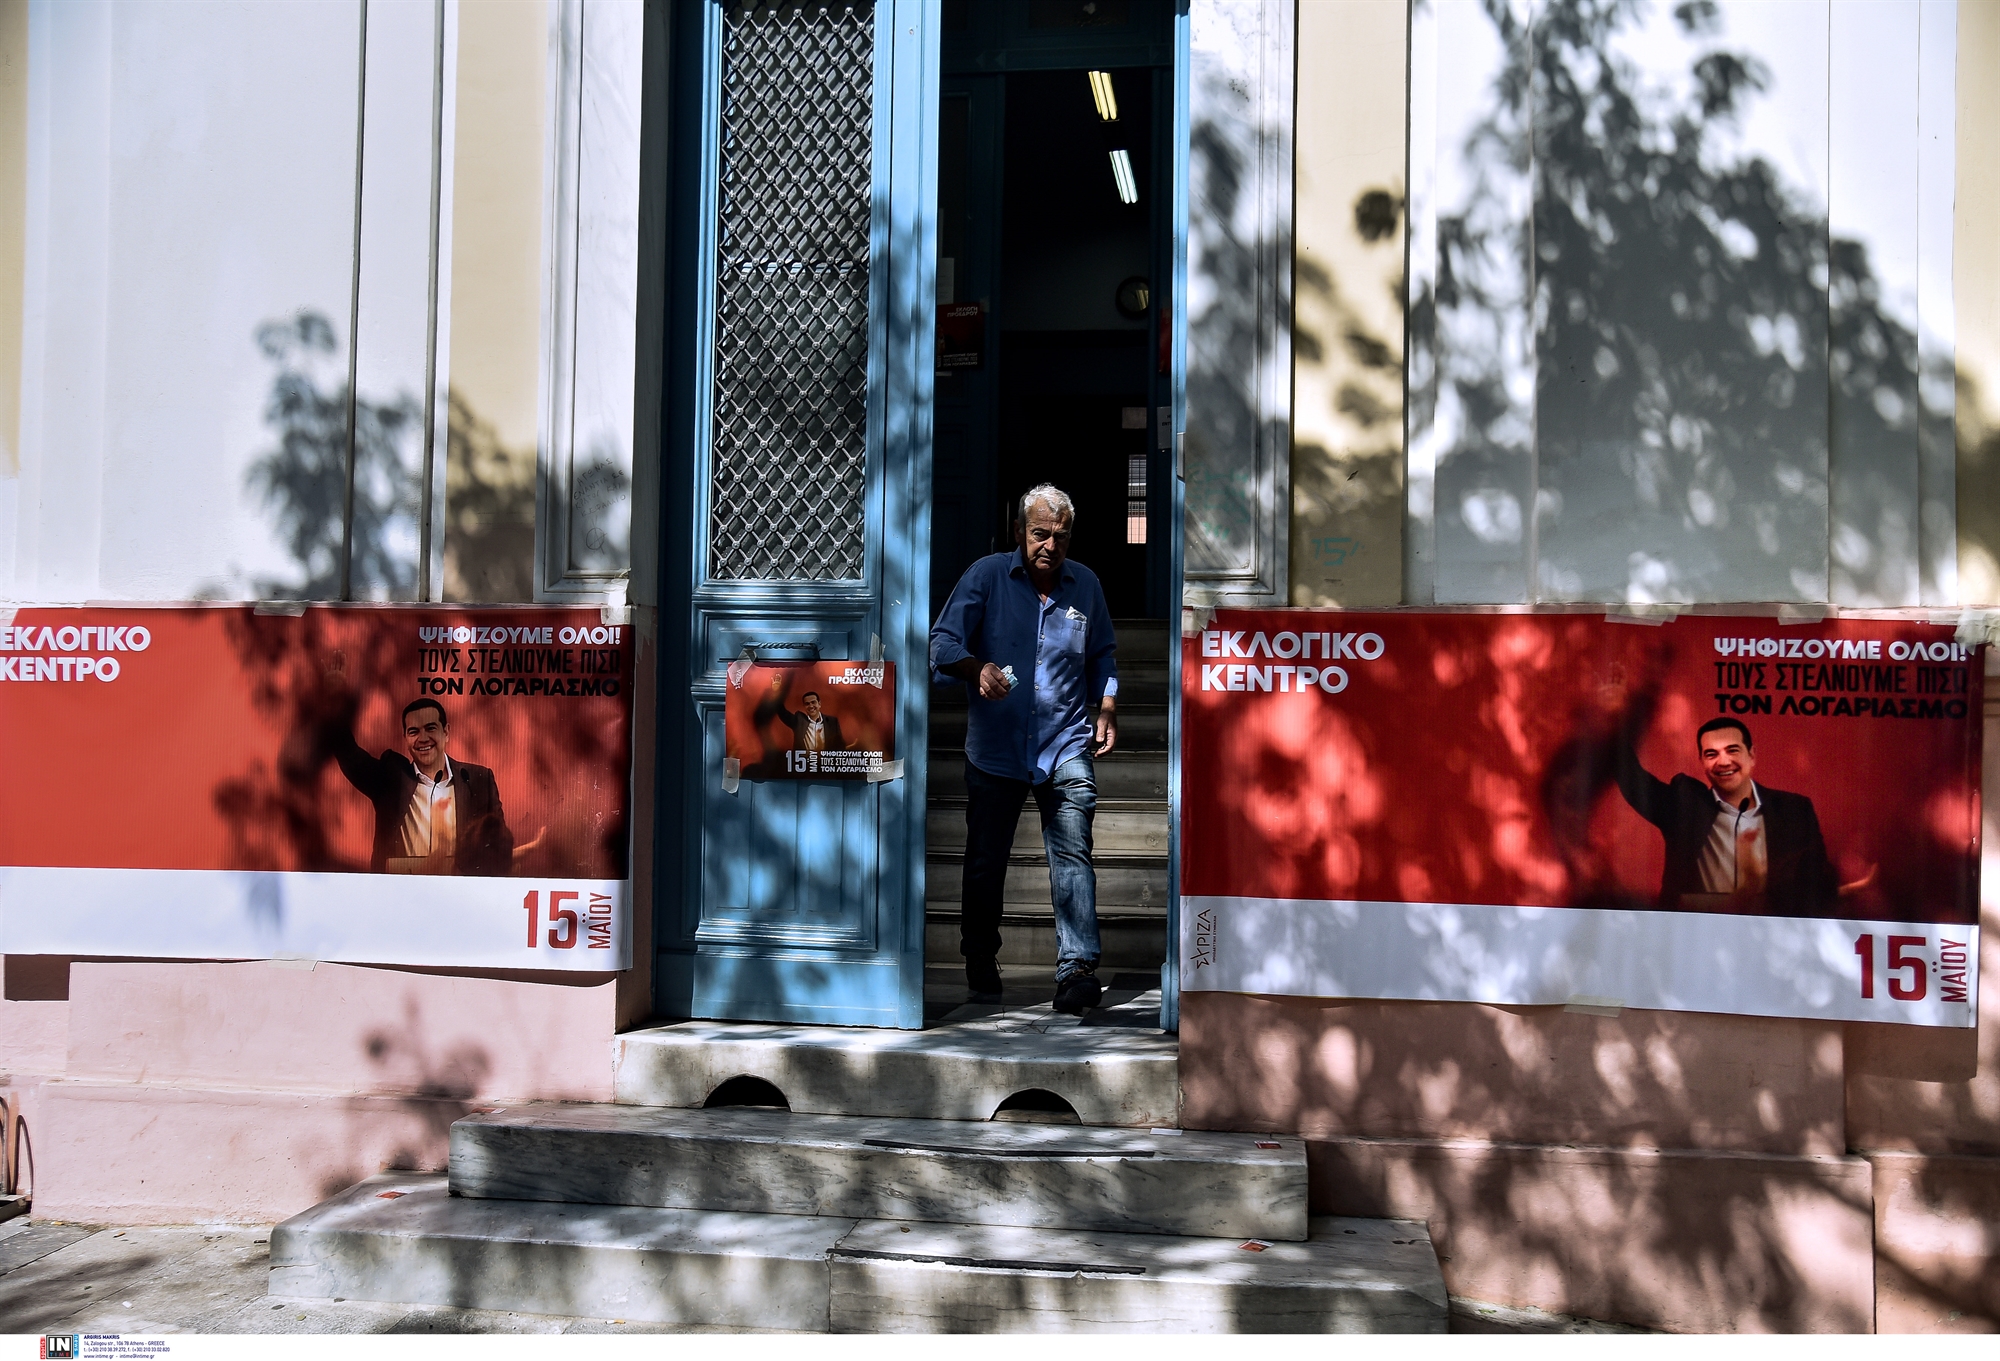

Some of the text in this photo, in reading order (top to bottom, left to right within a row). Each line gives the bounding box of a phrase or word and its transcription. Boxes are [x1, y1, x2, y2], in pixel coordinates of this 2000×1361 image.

[0, 626, 151, 651] ΕΚΛΟΓΙΚΟ
[419, 626, 620, 644] ΨΗΦΙΖΟΥΜΕ ΟΛΟΙ!
[1202, 631, 1385, 660] ΕΚΛΟΓΙΚΟ
[418, 649, 620, 673] ΤΟΥΣ ΣΤΕΛΝΟΥΜΕ ΠΙΣΩ
[1714, 637, 1967, 662] ΨΗΦΙΖΟΥΜΕ ΟΛΟΙ!
[0, 656, 120, 682] ΚΕΝΤΡΟ
[828, 676, 883, 684] ΠΡΟΕΔΡΟΥ
[844, 668, 883, 676] ΕΚΛΟΓΗ
[1202, 664, 1348, 694] ΚΕΝΤΡΟ
[1714, 662, 1967, 694] ΤΟΥΣ ΣΤΕΛΝΟΥΜΕ ΠΙΣΩ
[418, 678, 620, 696] ΤΟΝ ΛΟΓΑΡΙΑΣΜΟ
[1714, 694, 1967, 719] ΤΟΝ ΛΟΓΑΡΙΑΣΜΟ
[786, 750, 806, 772] 15
[836, 758, 868, 766] ΣΤΕΛΝΟΥΜΕ
[870, 758, 883, 766] ΠΙΣΩ
[523, 890, 578, 949] 15
[1190, 909, 1211, 969] ΣΥΡΙΖΑ
[1854, 933, 1927, 1001] 15
